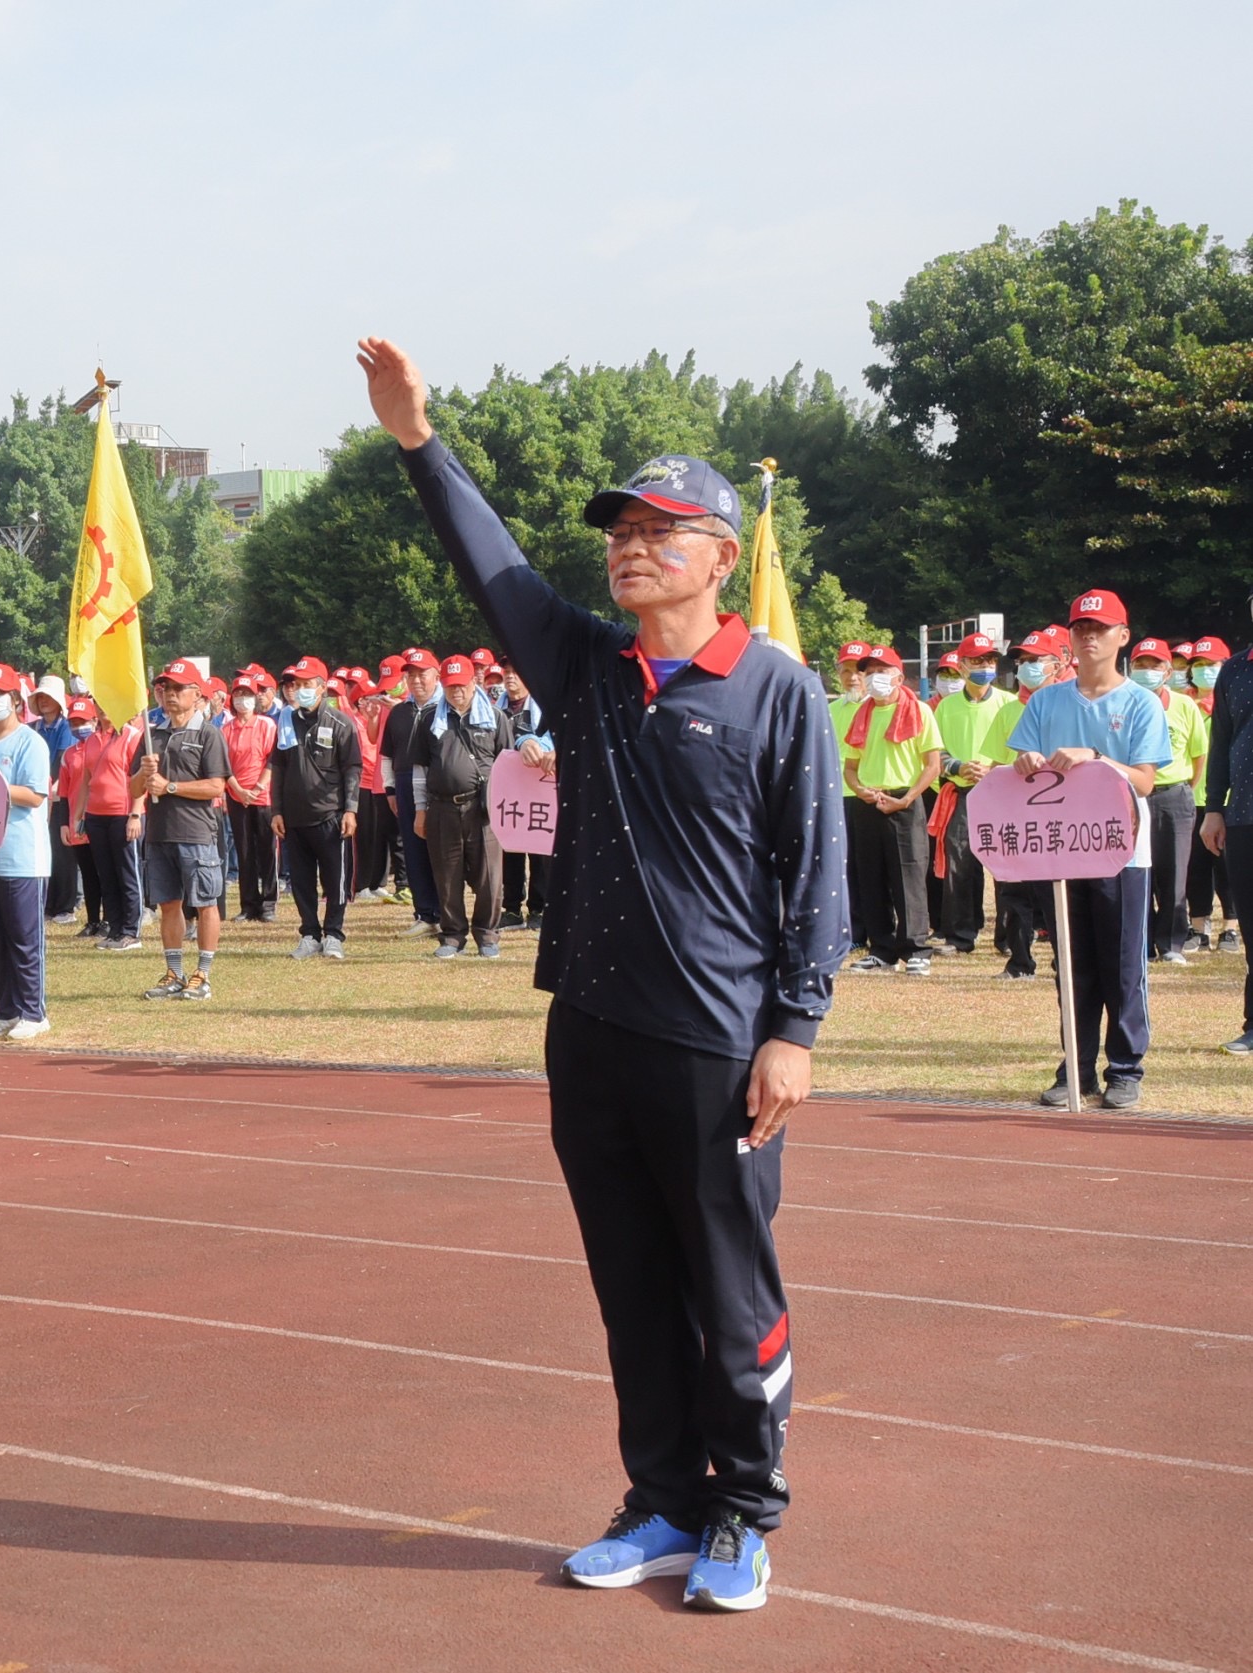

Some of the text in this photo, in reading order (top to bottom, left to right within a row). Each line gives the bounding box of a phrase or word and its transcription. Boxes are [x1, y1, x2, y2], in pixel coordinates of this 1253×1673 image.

[689, 719, 713, 735] FILA
[1024, 770, 1065, 805] 2
[496, 798, 554, 834] 仟臣
[977, 816, 1128, 857] 軍備局第209廠
